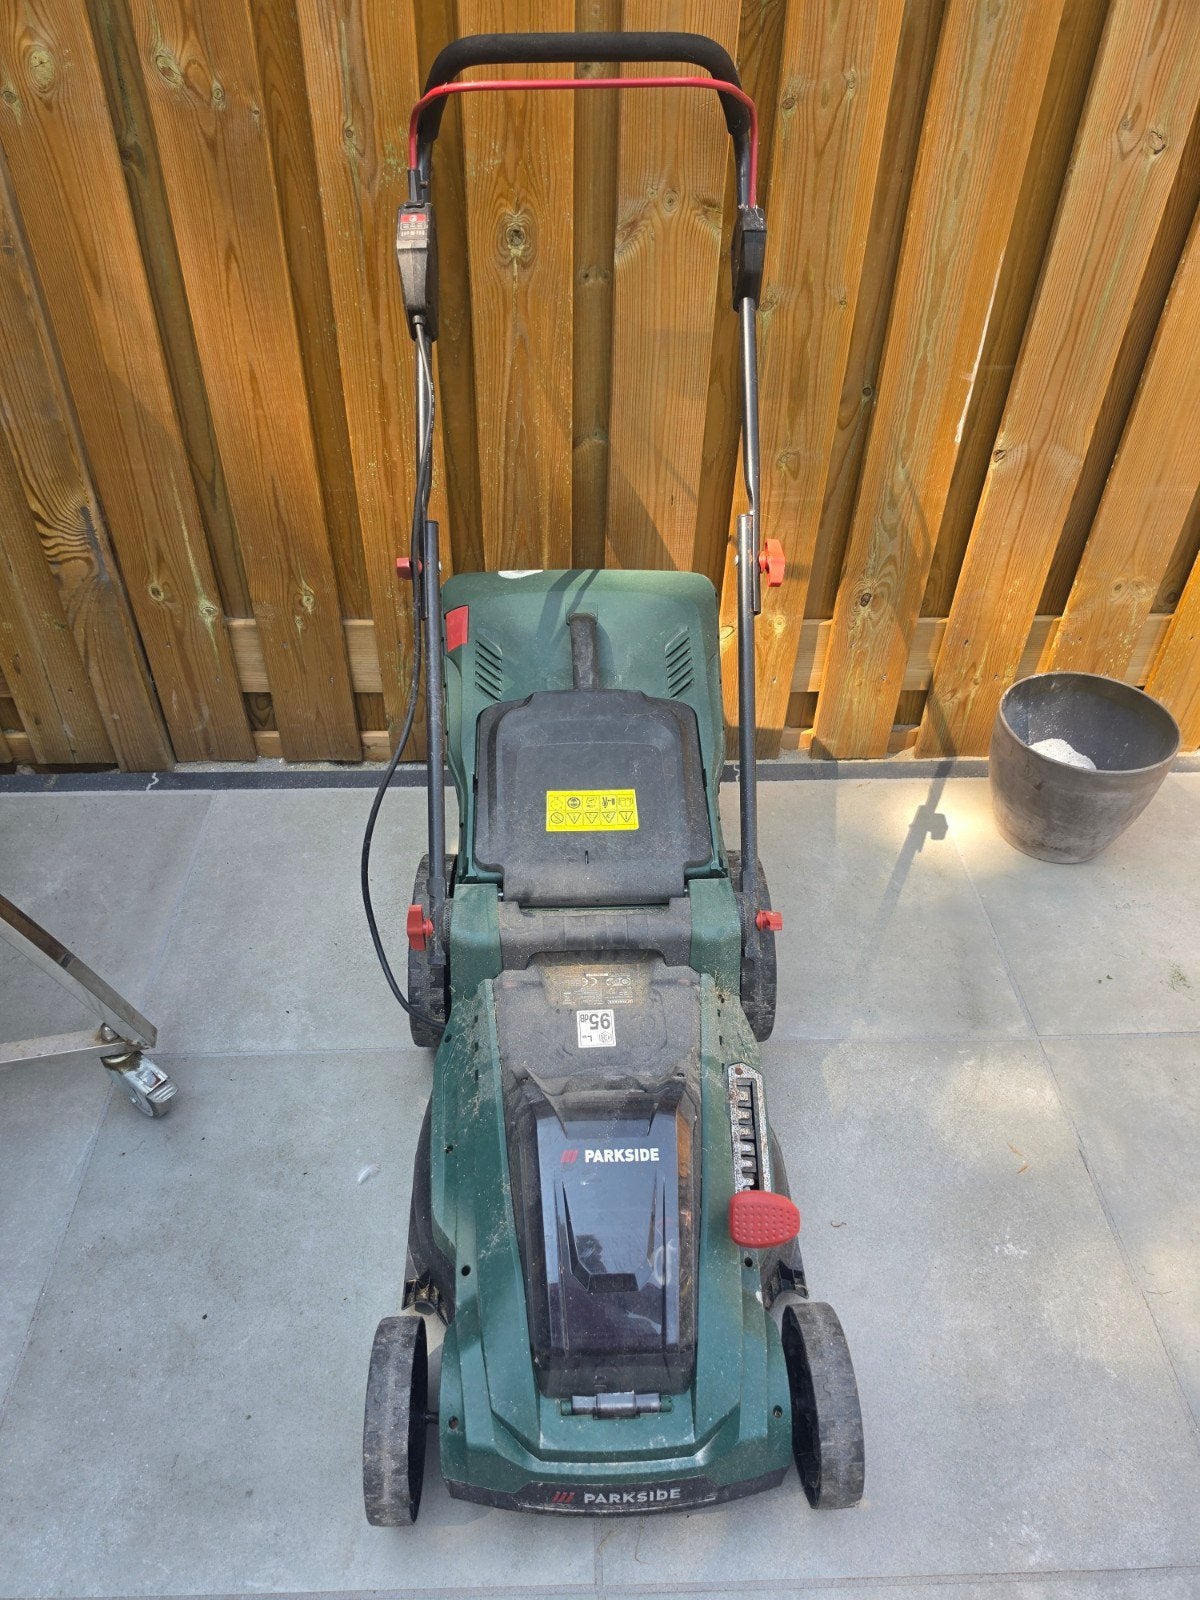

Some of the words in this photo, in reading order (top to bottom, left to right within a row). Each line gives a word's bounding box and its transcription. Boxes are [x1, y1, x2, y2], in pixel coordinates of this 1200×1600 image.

[589, 1012, 611, 1030] 95
[584, 1147, 660, 1163] PARKSIDE
[583, 1488, 681, 1504] PARKSIDE
